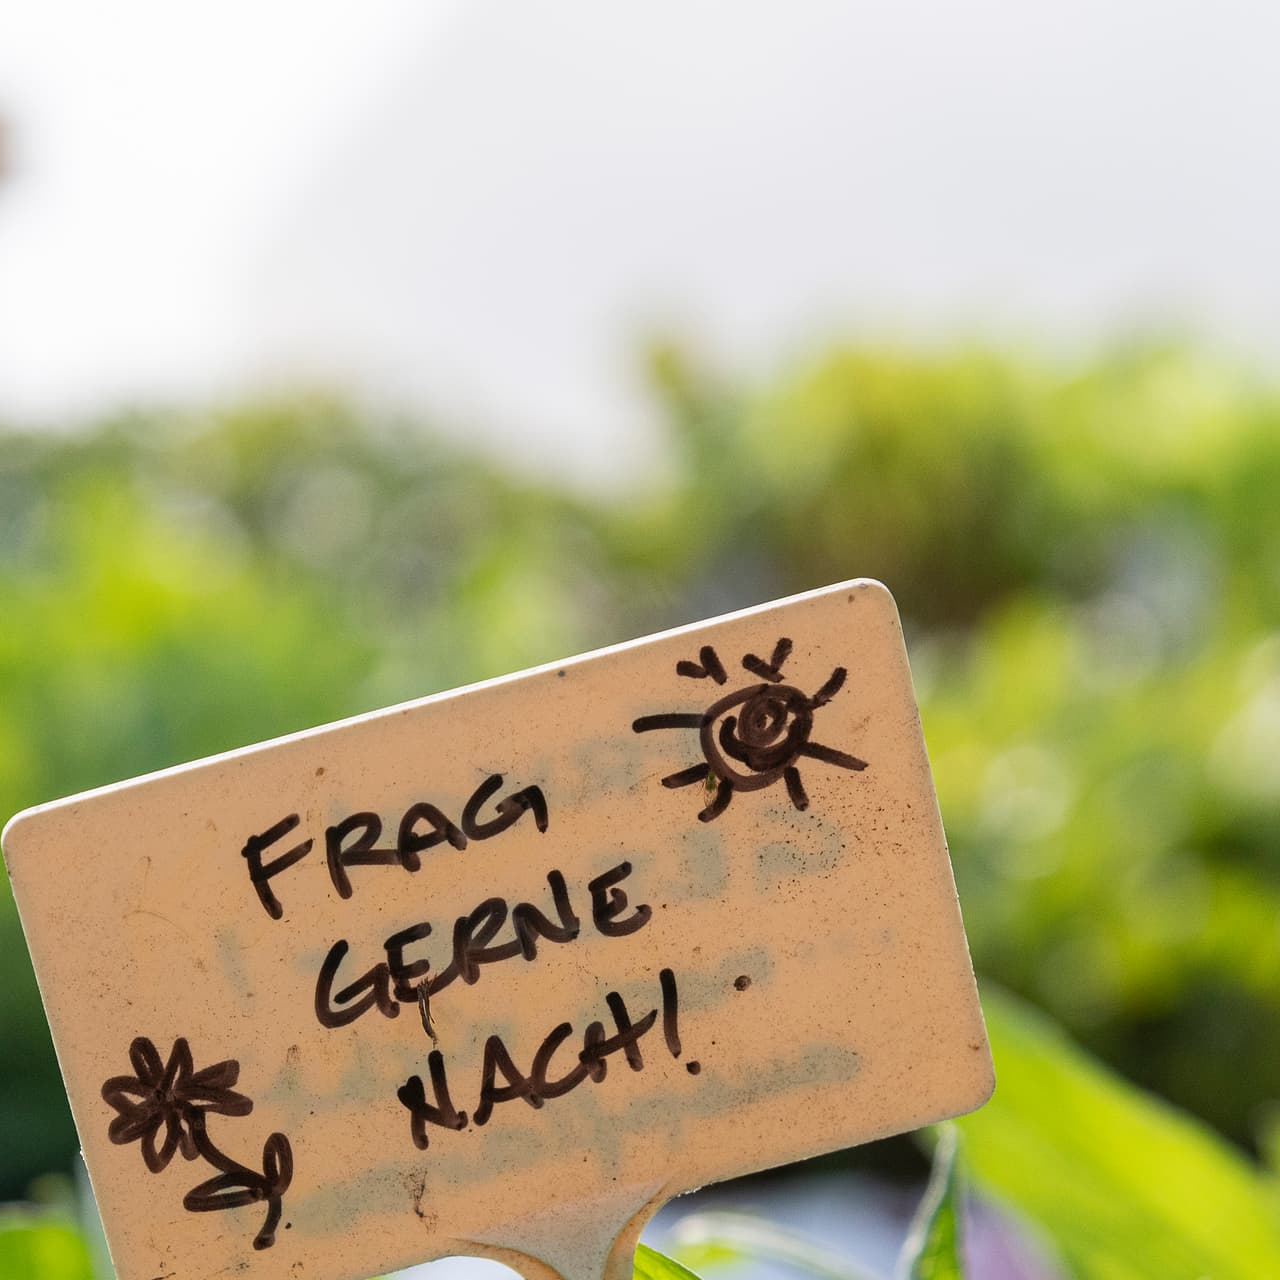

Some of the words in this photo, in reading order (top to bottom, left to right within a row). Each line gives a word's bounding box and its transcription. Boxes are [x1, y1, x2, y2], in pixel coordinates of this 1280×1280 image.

[242, 774, 550, 921] FRAG
[315, 862, 653, 1030] GERNE
[396, 968, 703, 1151] NACH!
